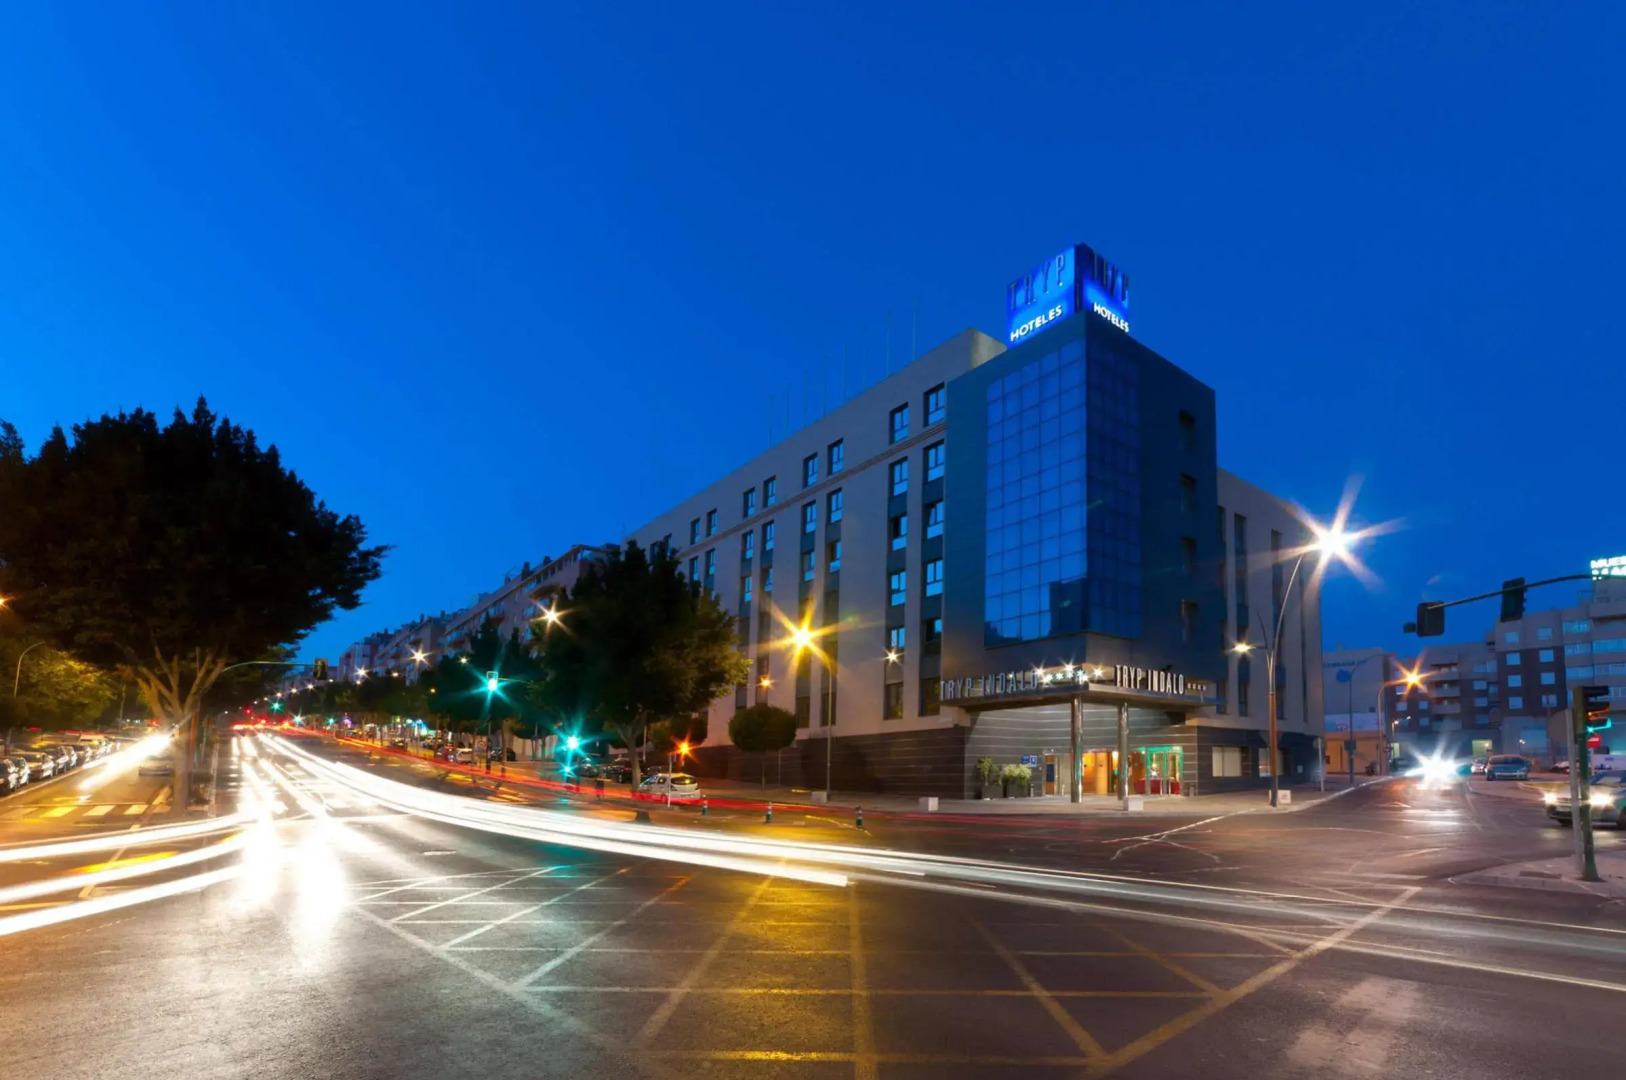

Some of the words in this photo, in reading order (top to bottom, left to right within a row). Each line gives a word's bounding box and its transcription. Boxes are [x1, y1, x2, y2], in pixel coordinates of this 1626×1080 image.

[1010, 305, 1063, 342] HOTELES
[1093, 302, 1129, 333] HOTELES
[940, 677, 973, 700] TRYP
[981, 667, 1038, 696] INDALO
[1116, 664, 1142, 689] TRYP
[1147, 669, 1184, 695] INDALO
